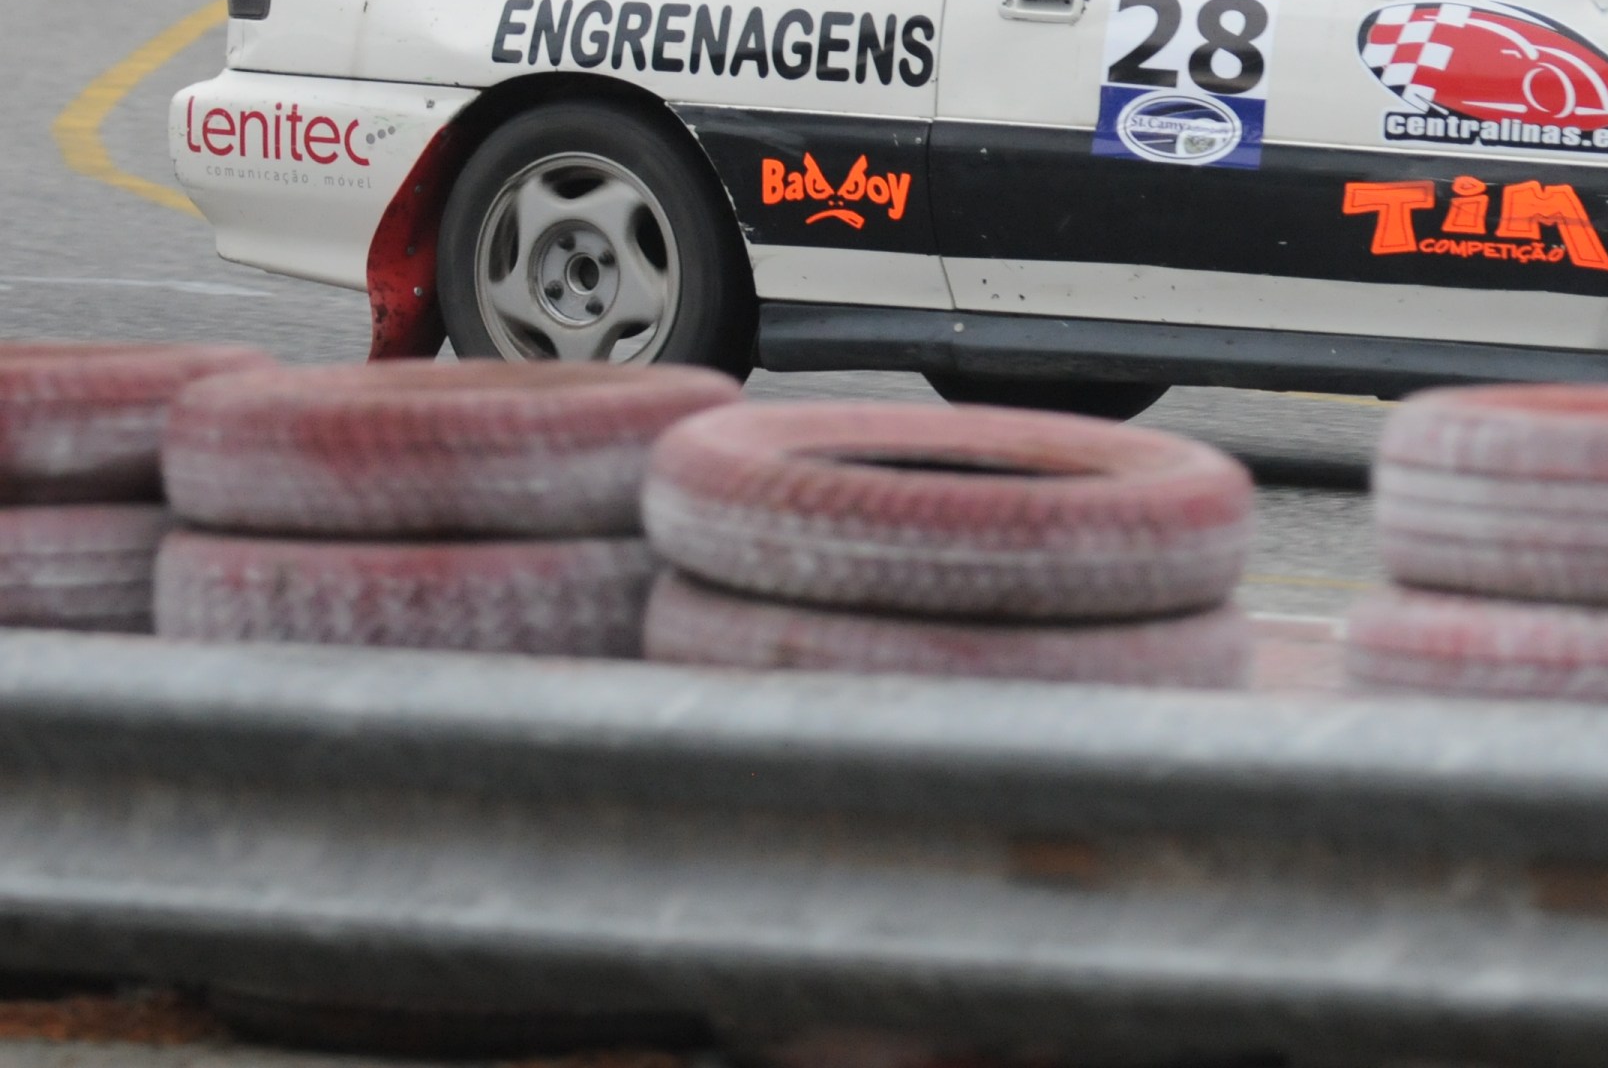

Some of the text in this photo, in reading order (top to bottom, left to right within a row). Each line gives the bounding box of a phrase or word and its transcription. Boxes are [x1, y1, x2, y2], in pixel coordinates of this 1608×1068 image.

[206, 164, 372, 189] comunicação móvel
[1419, 237, 1567, 264] COMPETIÇÃO
